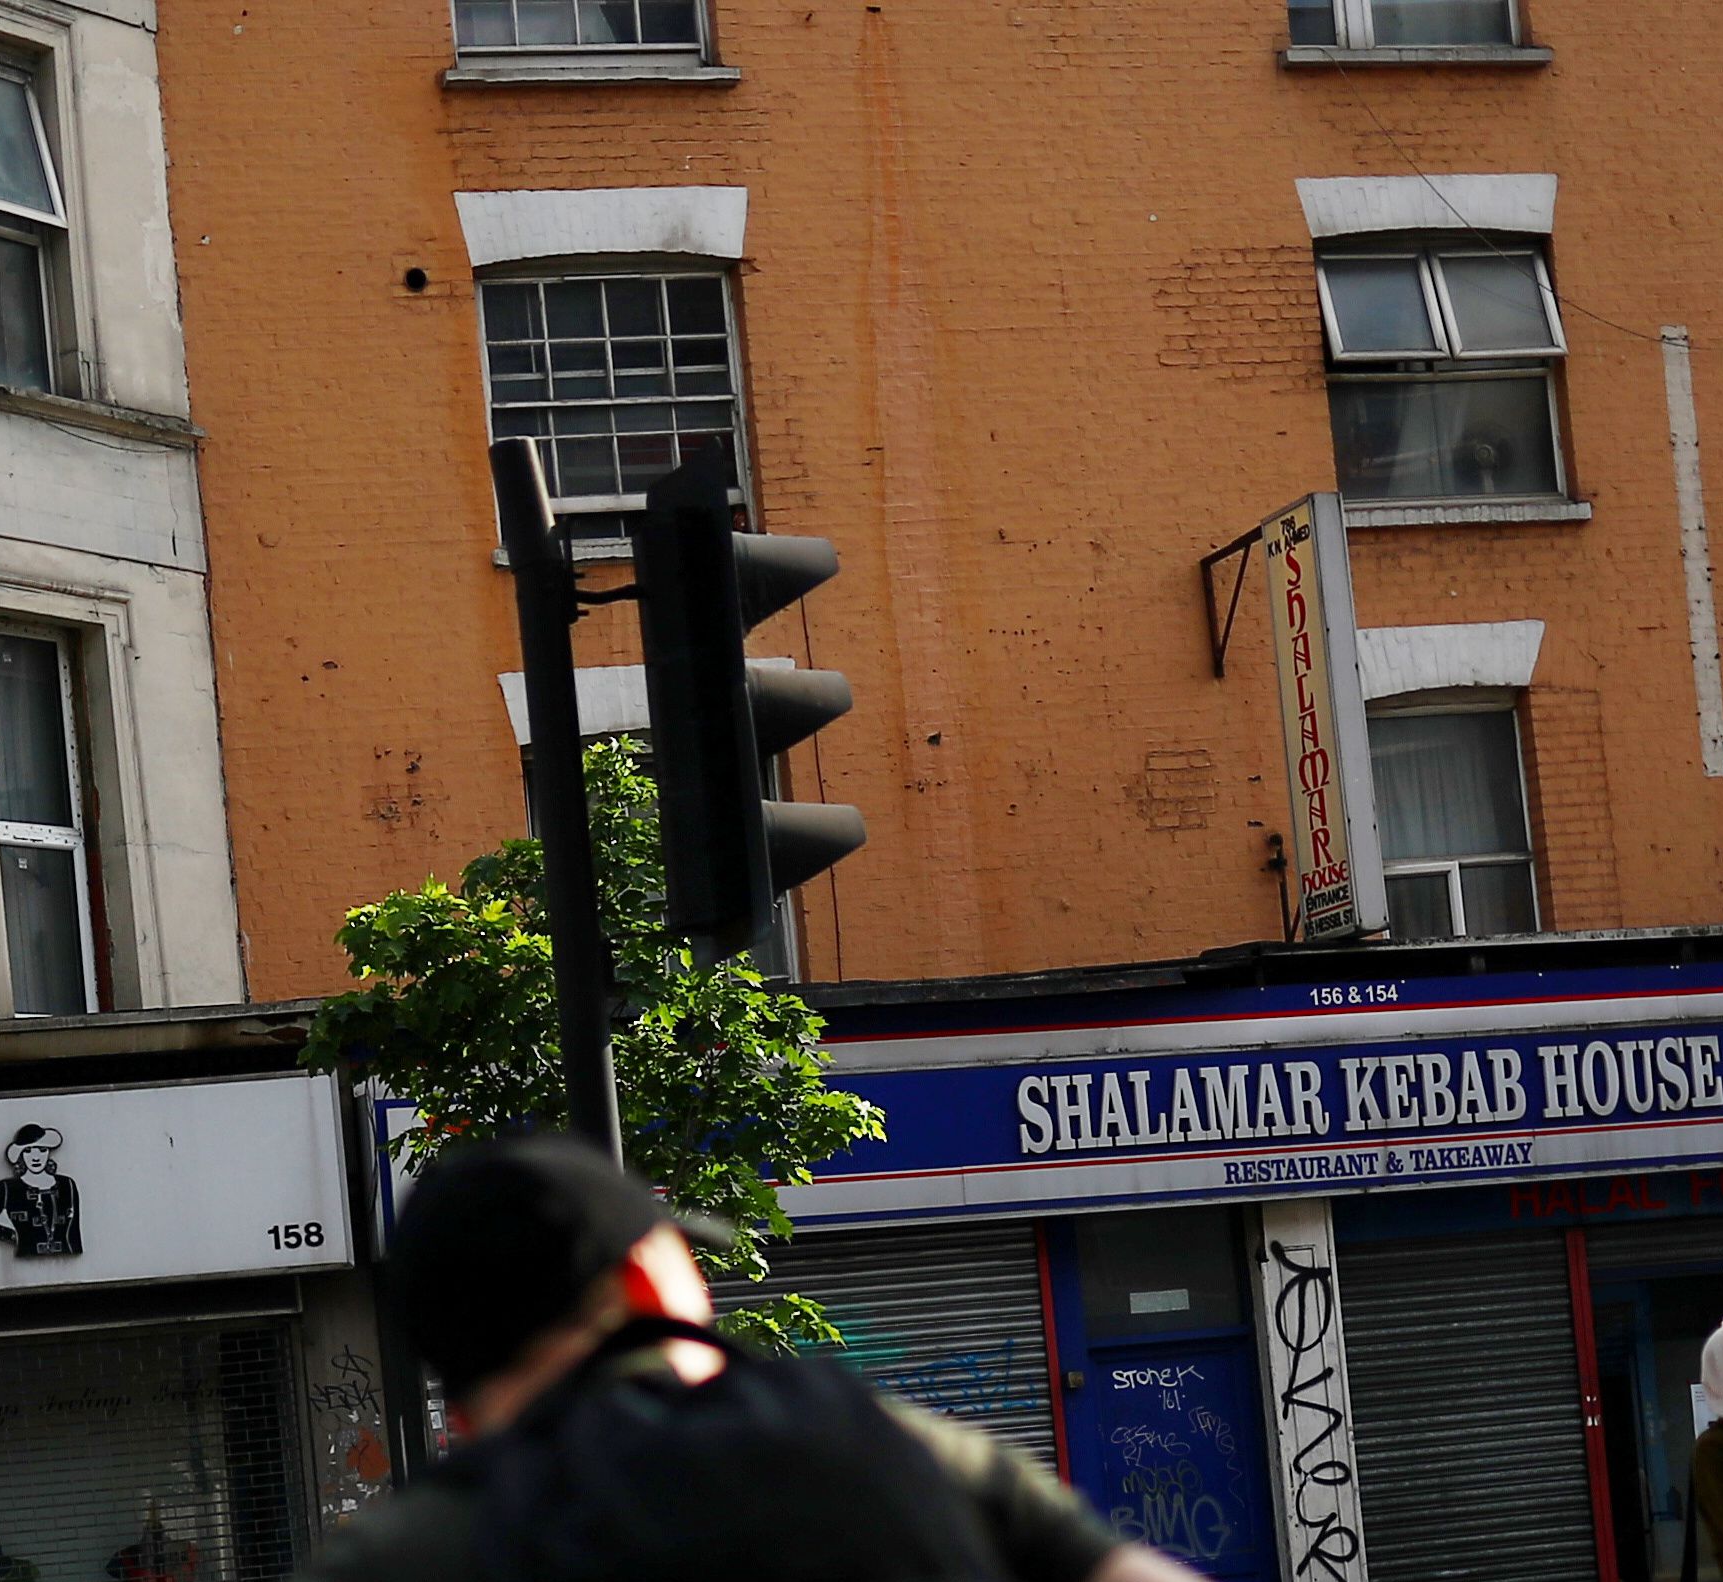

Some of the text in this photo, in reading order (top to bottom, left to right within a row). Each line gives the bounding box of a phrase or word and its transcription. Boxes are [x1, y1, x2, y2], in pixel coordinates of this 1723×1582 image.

[1306, 884, 1350, 912] ENTRANCE
[1309, 983, 1399, 1006] 156 & 154
[1016, 1036, 1723, 1154] SHALAMAR KEBAB HOUSE
[1224, 1142, 1534, 1185] RESTAURANT & TAKEAWAY
[1509, 1174, 1666, 1220] HALAL
[265, 1221, 324, 1251] 158
